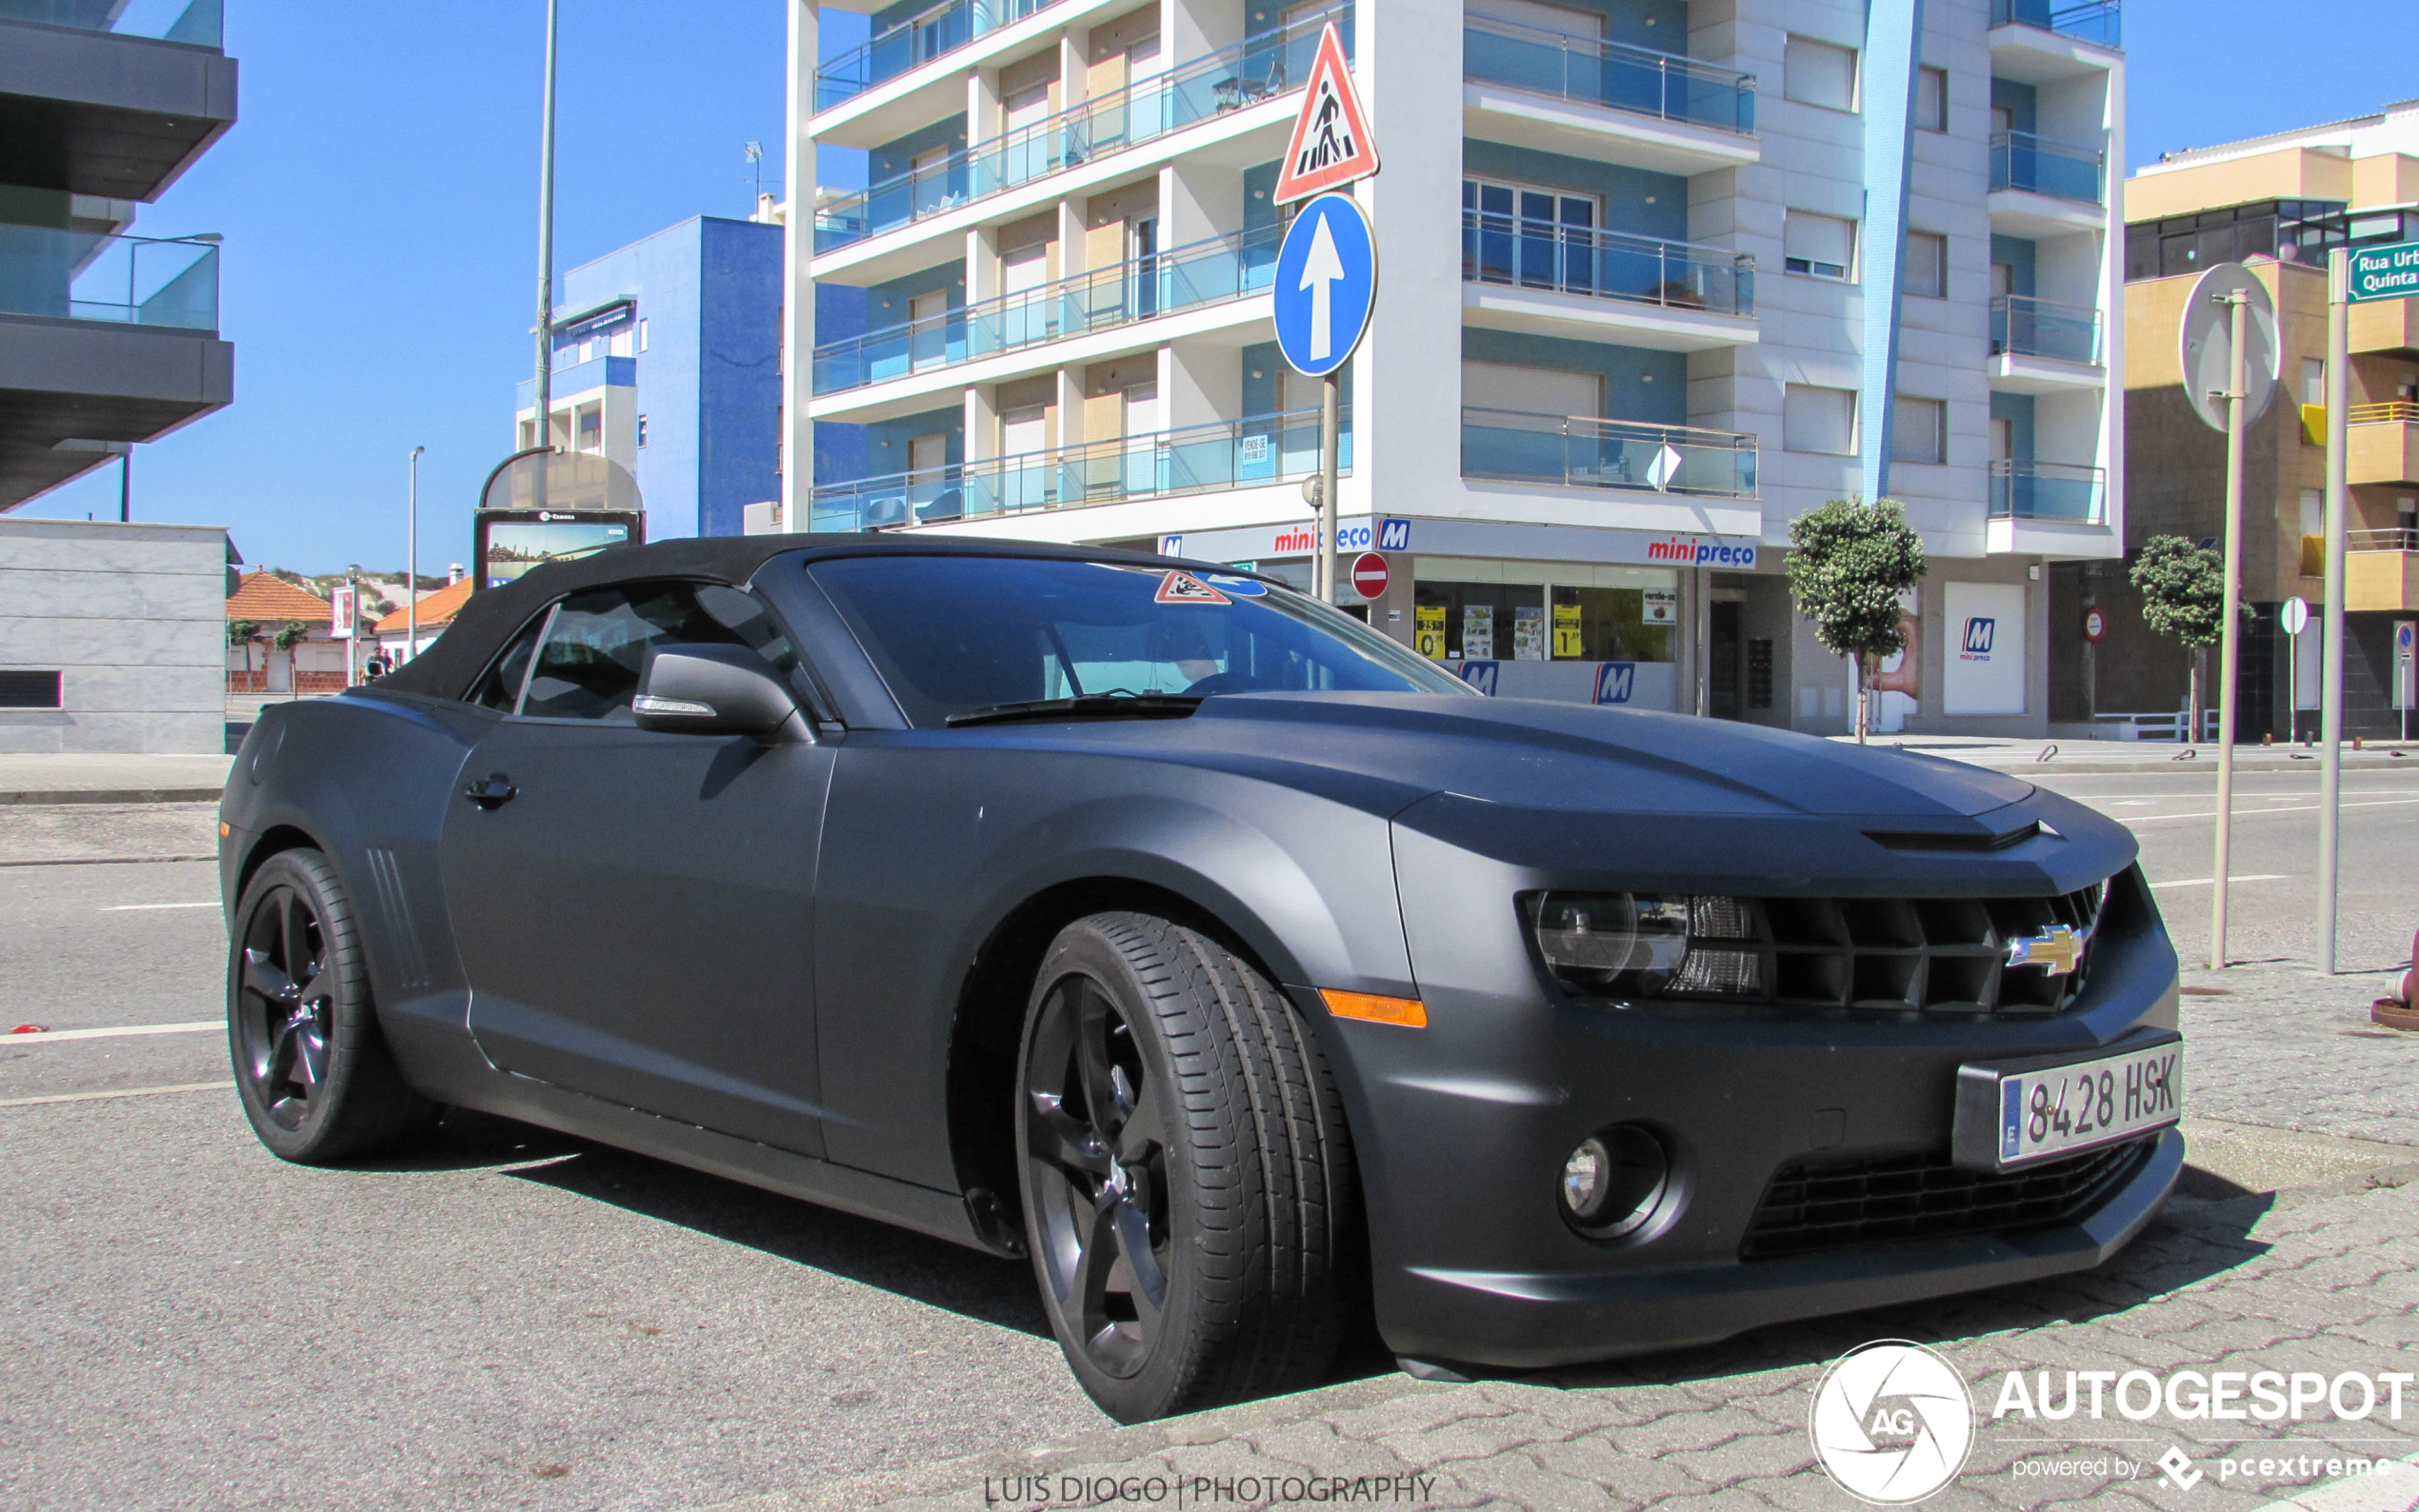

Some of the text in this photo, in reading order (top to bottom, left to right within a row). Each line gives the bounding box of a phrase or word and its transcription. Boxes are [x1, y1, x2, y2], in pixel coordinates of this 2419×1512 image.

[2359, 256, 2390, 272] Rua
[2363, 271, 2418, 291] Quinta
[1244, 438, 1266, 451] VENDE-SE
[1648, 536, 1754, 567] minipreço
[2029, 1054, 2176, 1144] 8428 HSK
